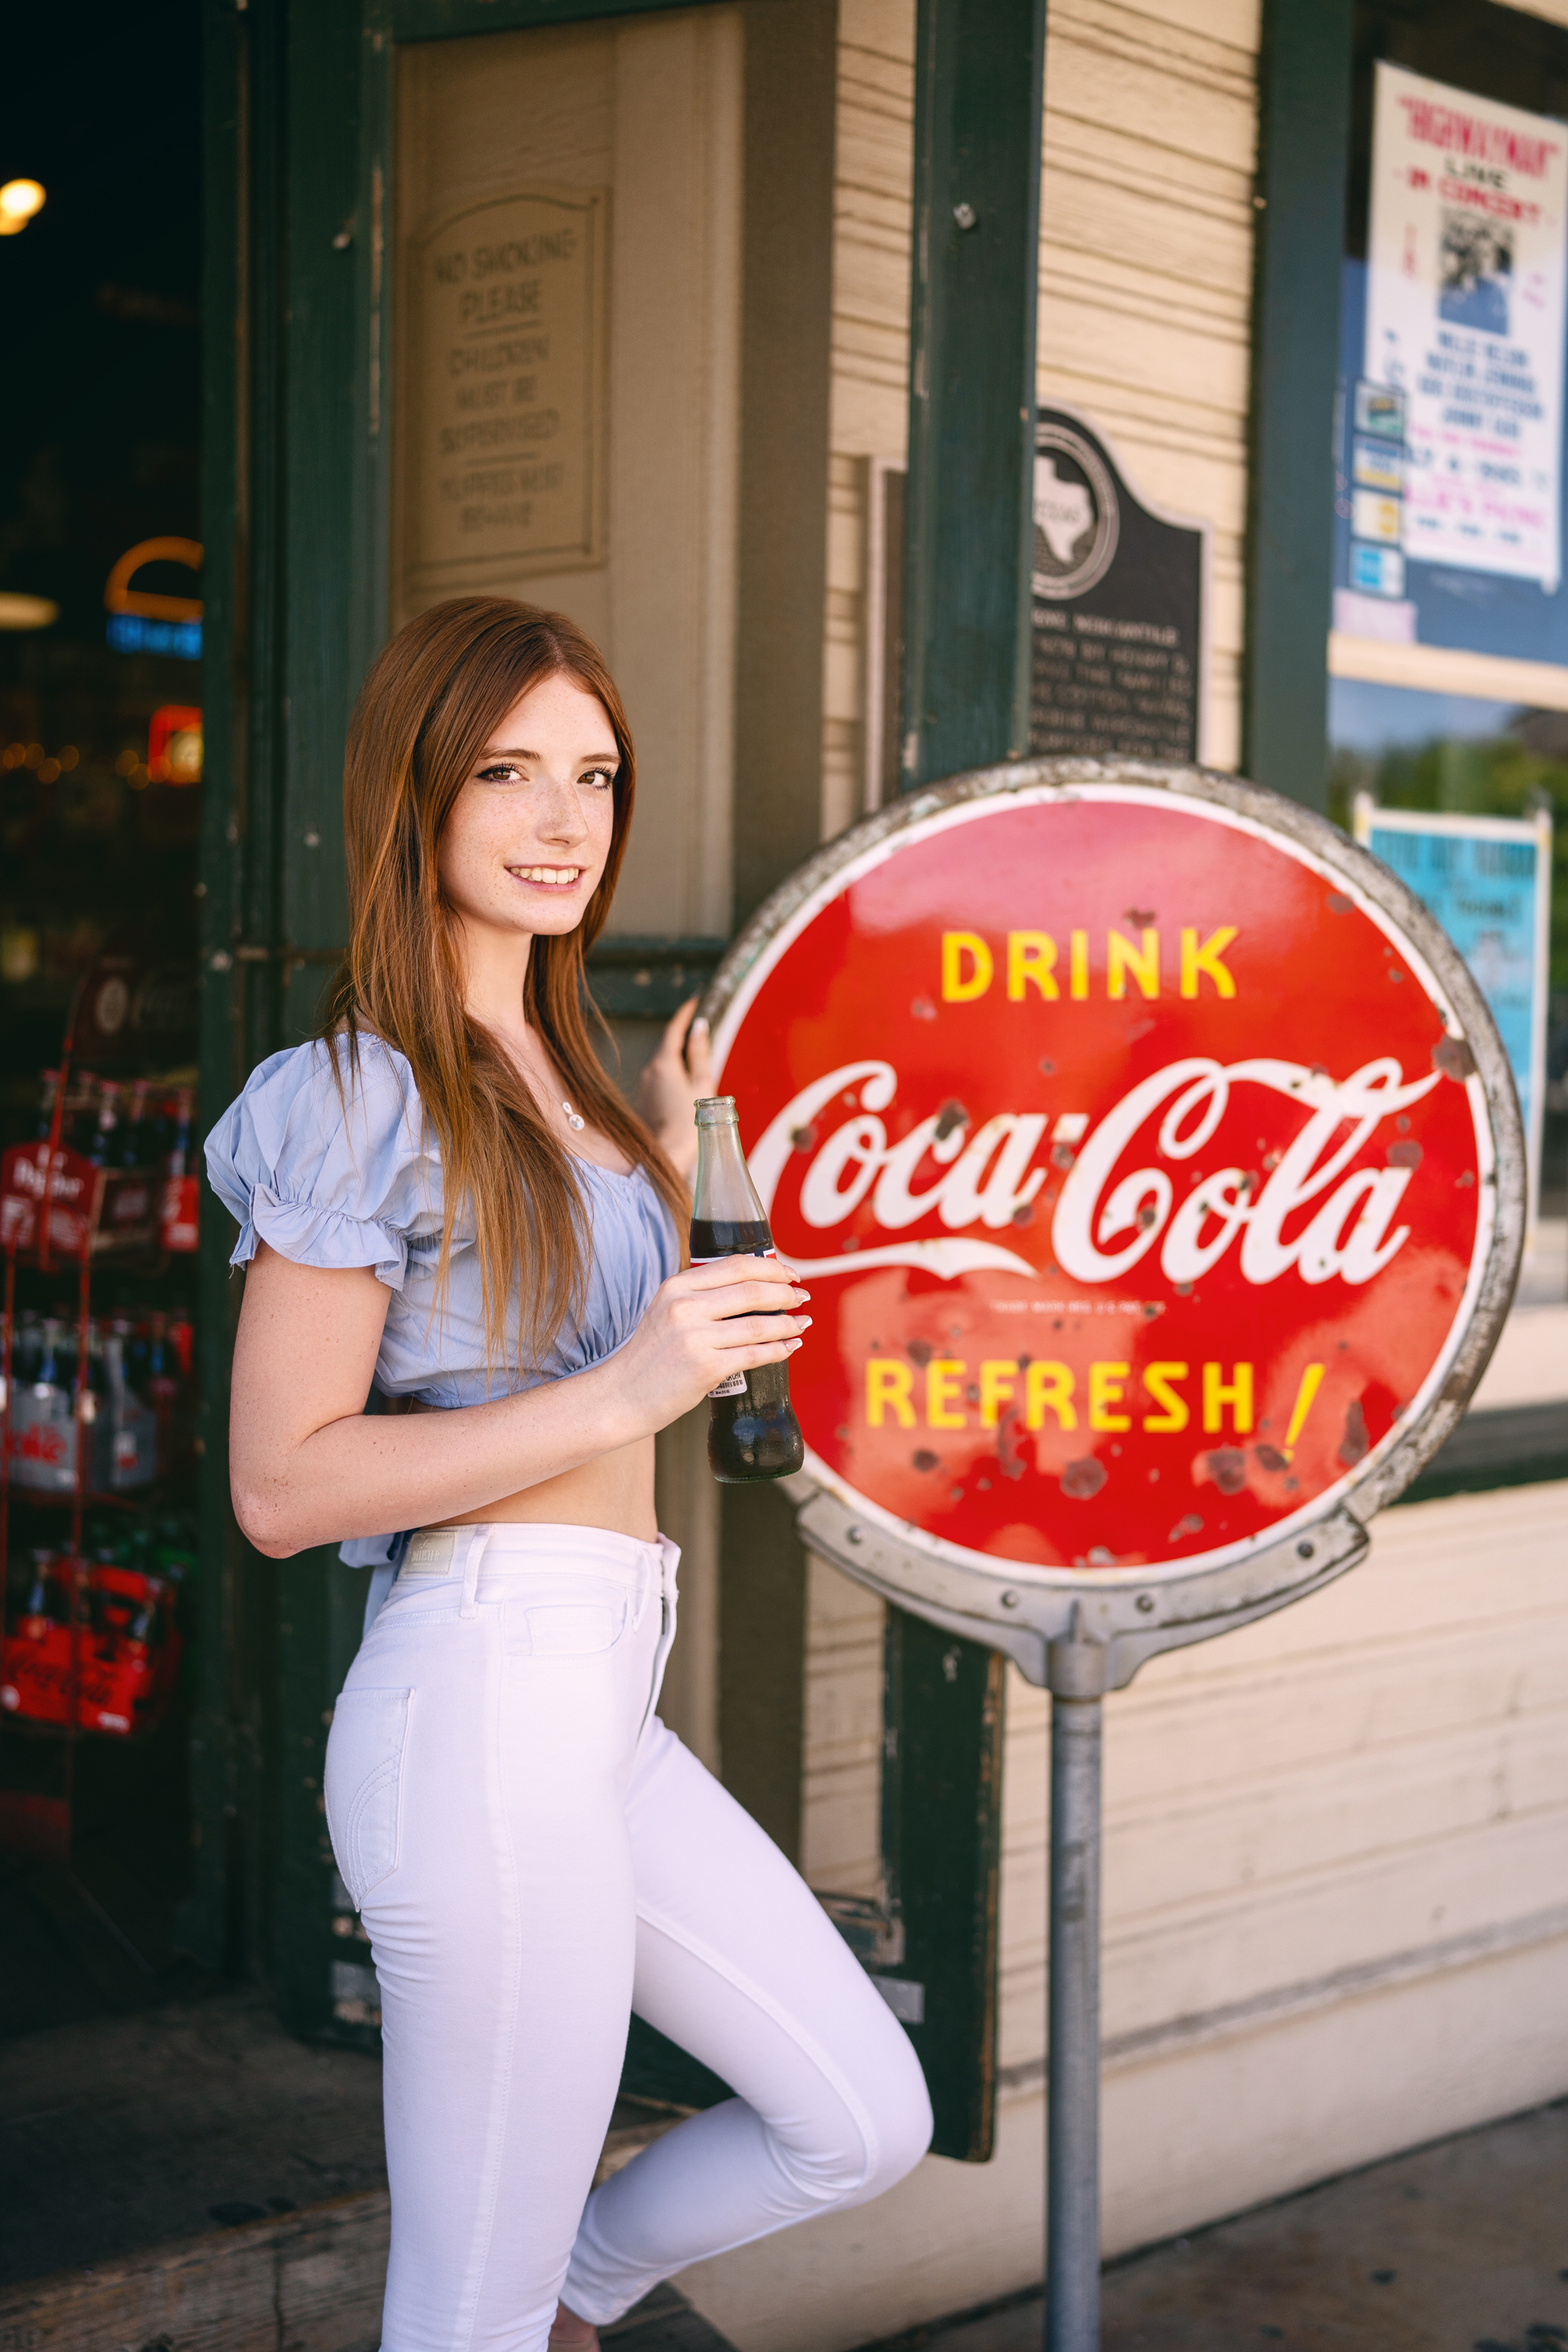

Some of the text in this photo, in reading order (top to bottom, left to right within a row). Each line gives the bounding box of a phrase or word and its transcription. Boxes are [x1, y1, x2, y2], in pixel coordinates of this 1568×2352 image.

[1443, 152, 1509, 190] LIVE
[459, 278, 543, 324] PLEASE
[942, 925, 1239, 1004] DRINK
[742, 1056, 1444, 1284] Coca-Cola
